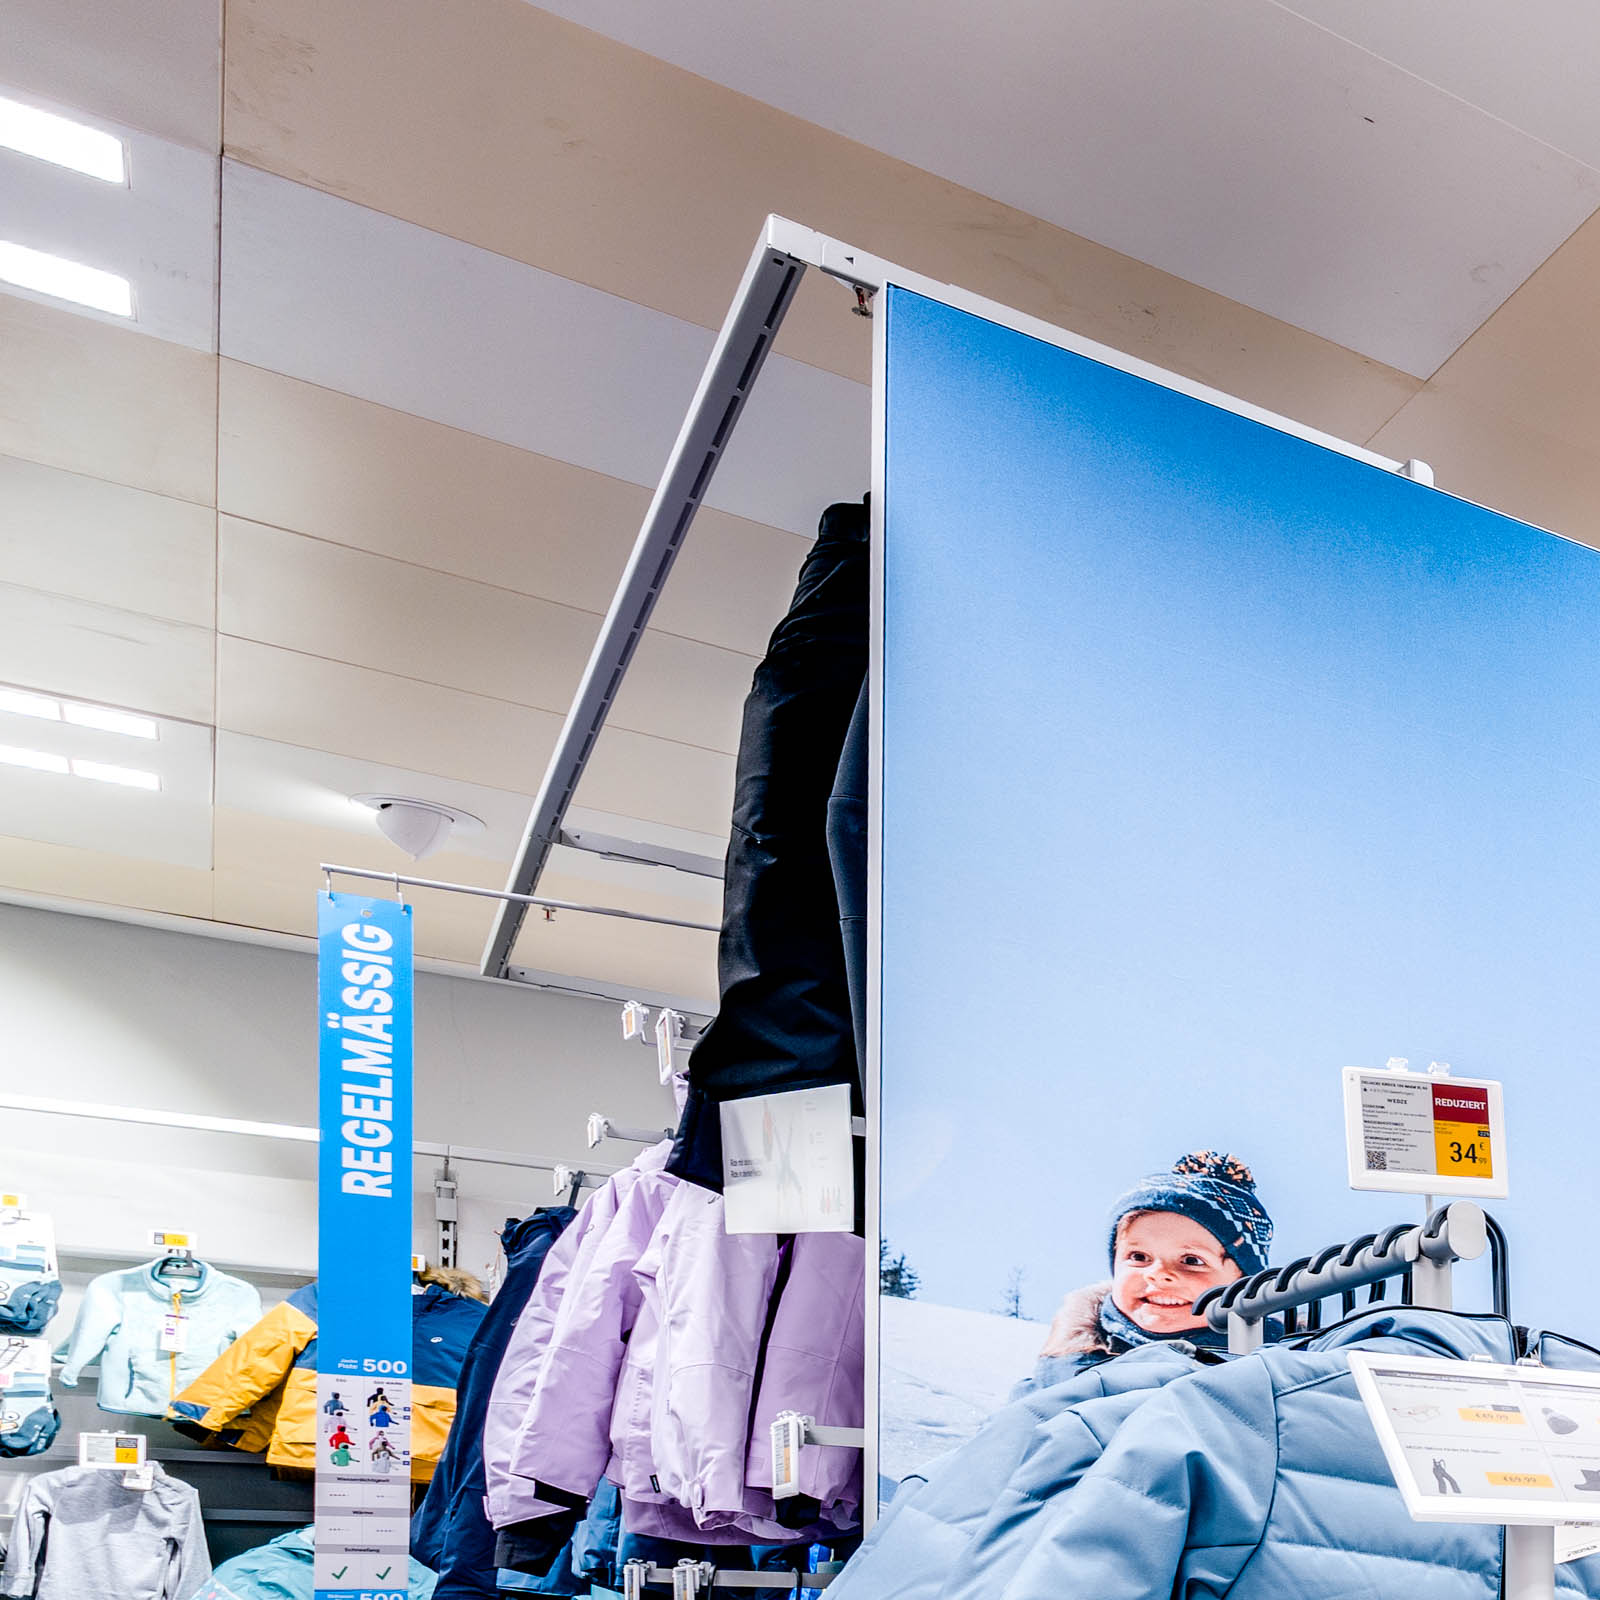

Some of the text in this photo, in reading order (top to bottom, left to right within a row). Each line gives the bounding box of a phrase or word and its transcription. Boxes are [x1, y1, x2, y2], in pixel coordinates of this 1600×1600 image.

[327, 923, 394, 1198] REGELMÄSSIG
[1434, 1097, 1487, 1111] REDUZIERT
[1450, 1141, 1478, 1164] 34
[363, 1358, 408, 1374] 500
